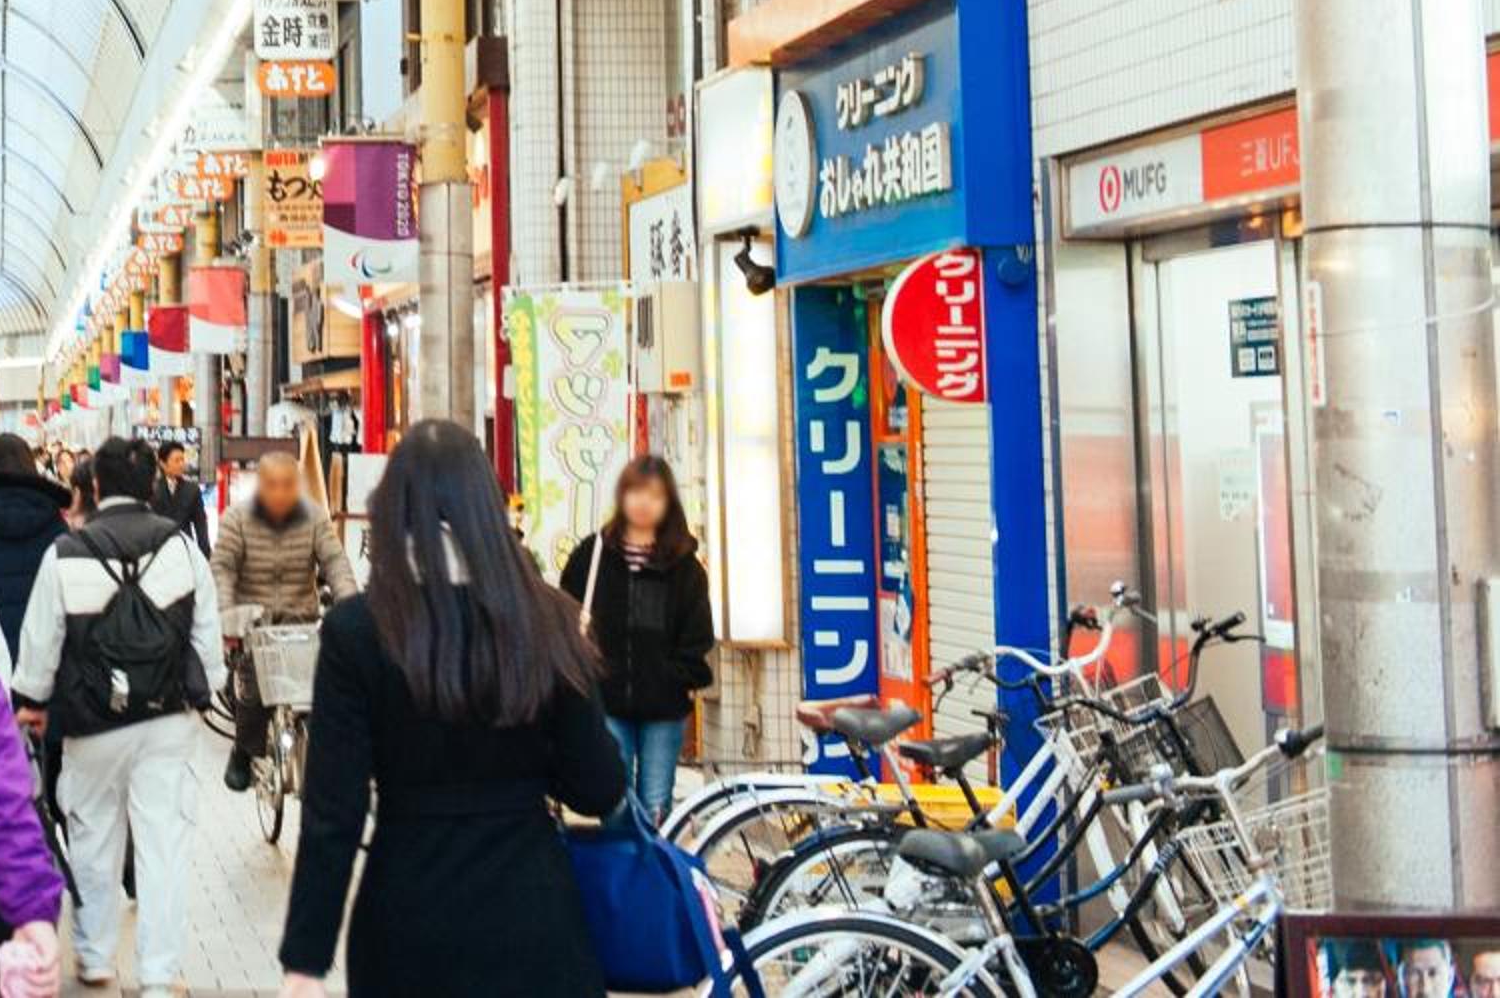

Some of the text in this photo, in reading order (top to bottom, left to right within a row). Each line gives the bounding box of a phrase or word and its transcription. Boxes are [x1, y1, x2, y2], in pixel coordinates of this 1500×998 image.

[261, 14, 303, 49] 金時
[266, 64, 326, 92] あすと
[835, 51, 925, 131] クリーニング
[818, 121, 952, 219] おしゃれ共和国
[1122, 161, 1167, 202] MUFG
[933, 248, 981, 401] クリーニング
